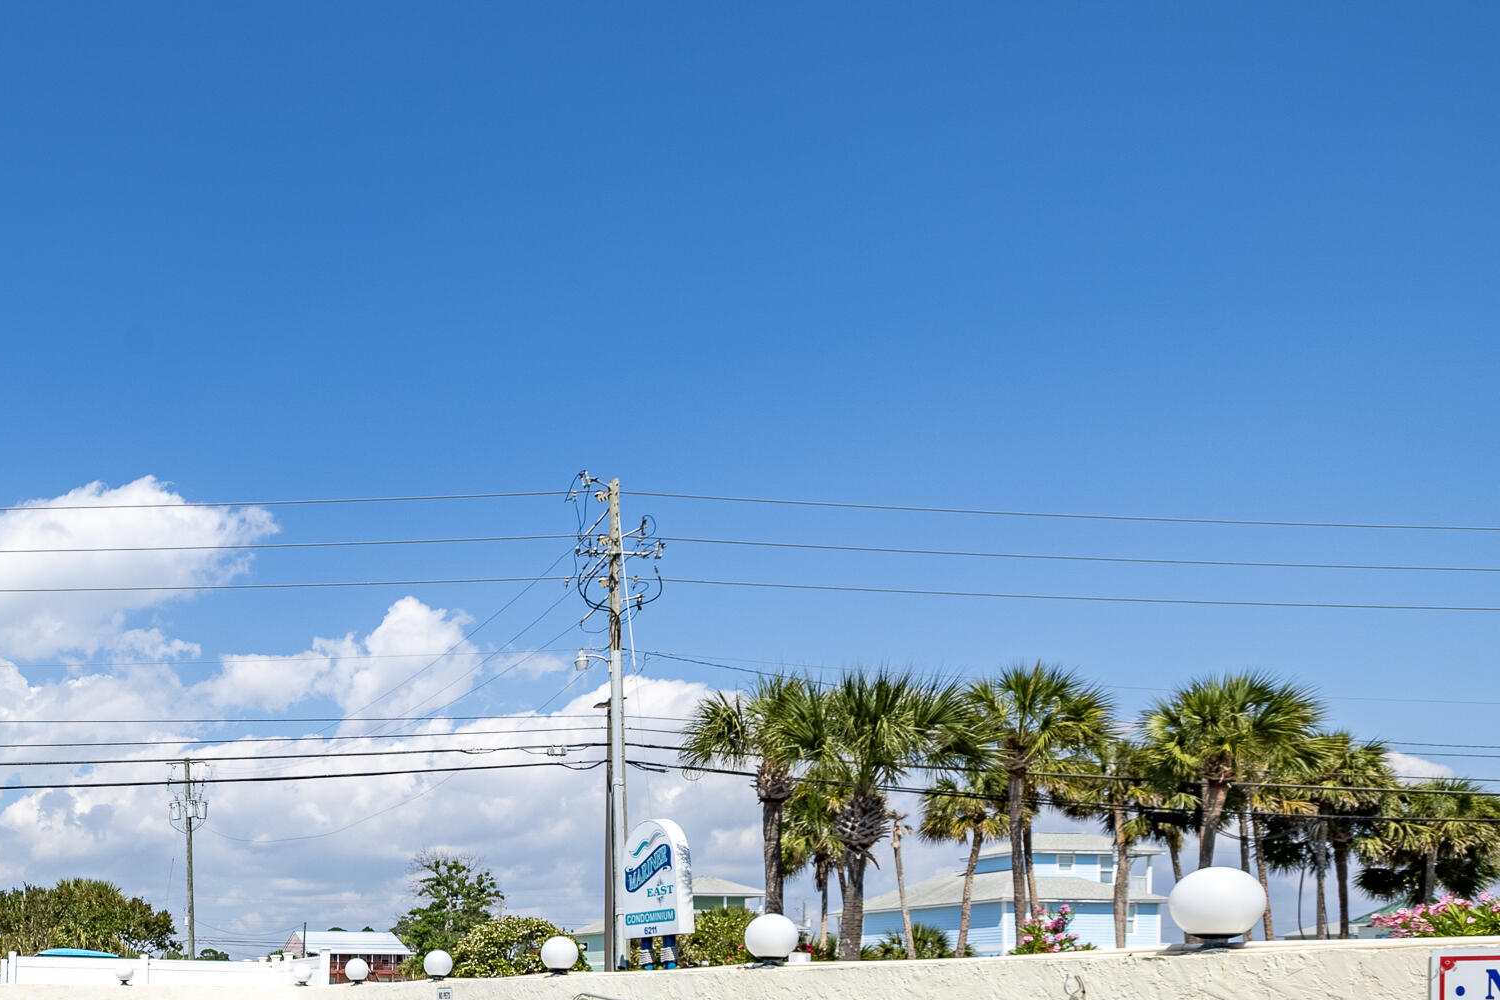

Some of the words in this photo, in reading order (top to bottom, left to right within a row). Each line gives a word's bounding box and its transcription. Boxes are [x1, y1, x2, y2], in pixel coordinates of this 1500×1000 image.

[627, 845, 668, 891] MARINER
[646, 884, 674, 898] EAST
[626, 911, 674, 924] CONDOMINIUM
[644, 926, 657, 935] 6211
